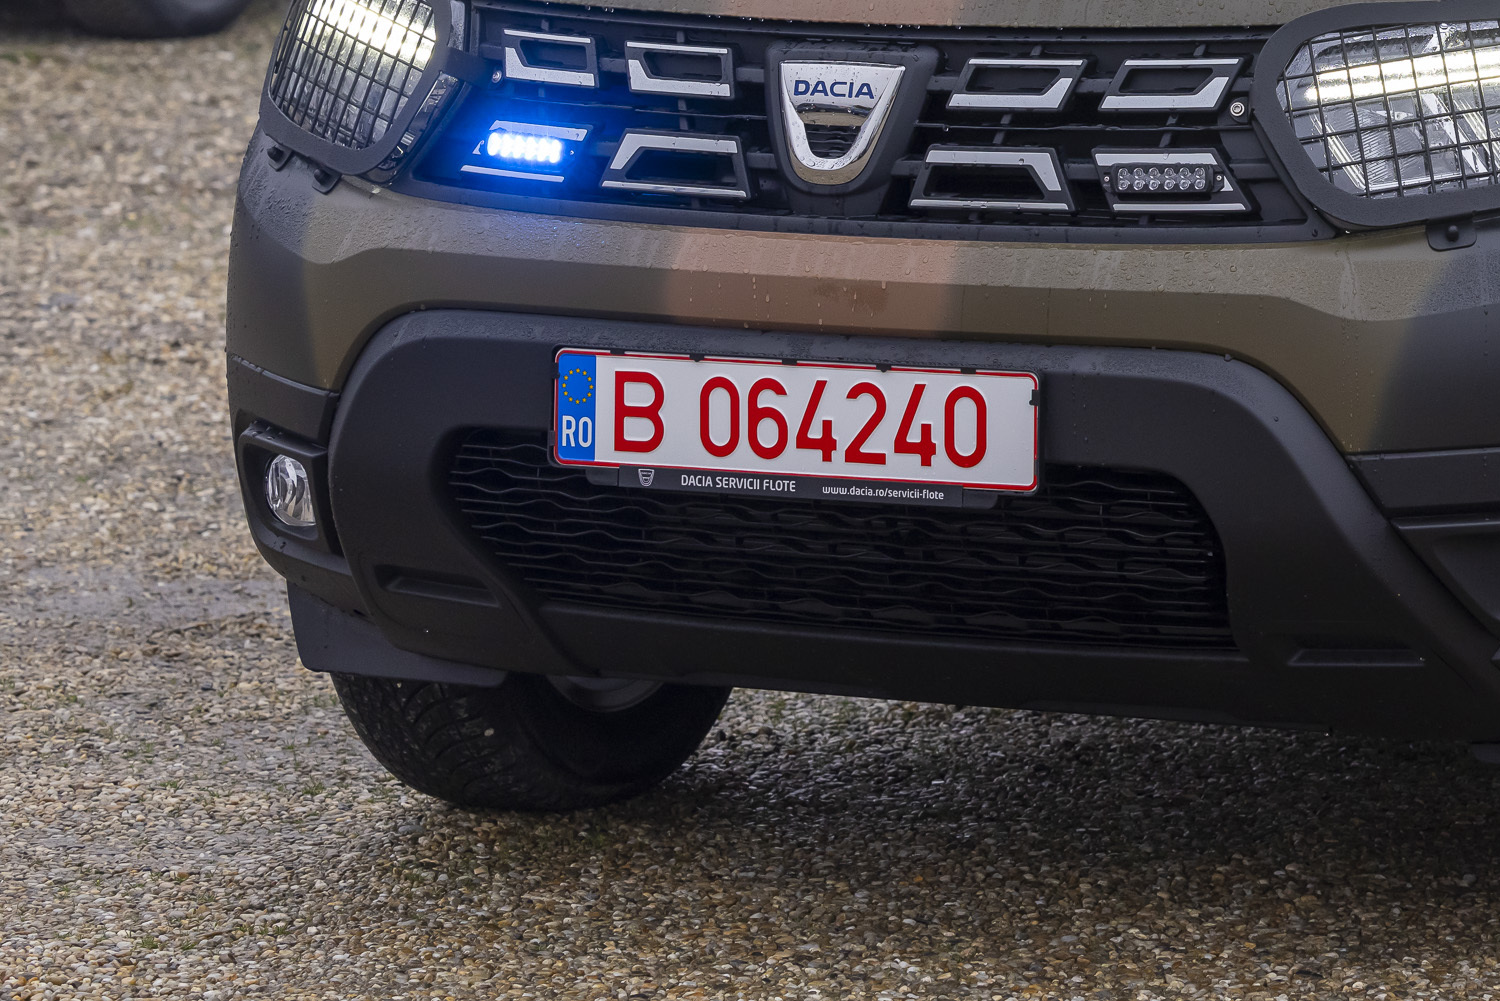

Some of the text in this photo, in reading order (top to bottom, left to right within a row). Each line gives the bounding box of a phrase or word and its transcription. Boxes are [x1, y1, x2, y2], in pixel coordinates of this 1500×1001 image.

[793, 79, 875, 100] DACIA
[614, 370, 988, 468] B 064240
[561, 415, 593, 448] RO
[680, 474, 796, 492] DACIA SERVICII FLOTE
[822, 485, 945, 500] www.dacia.ro/servicii-flote
